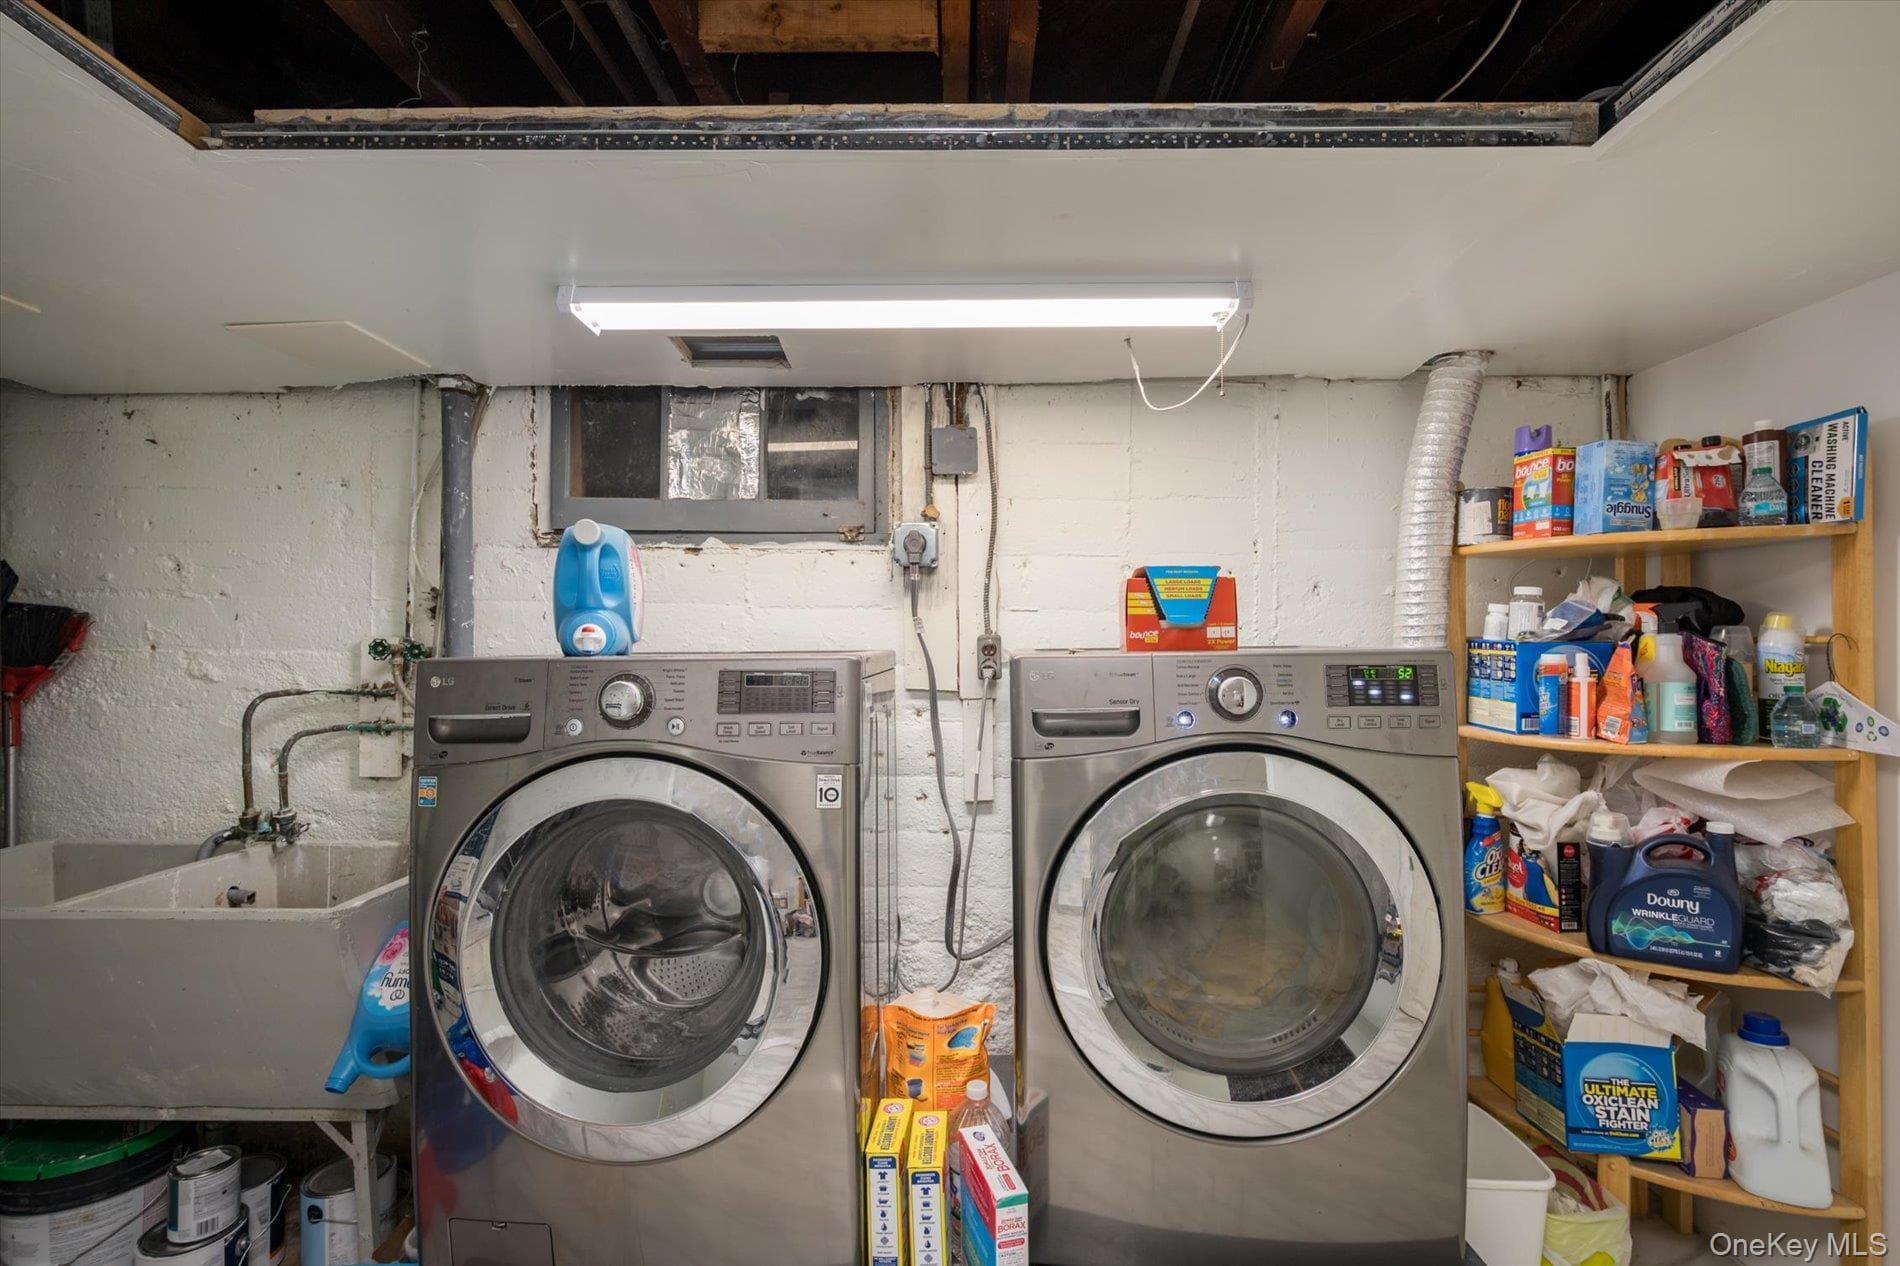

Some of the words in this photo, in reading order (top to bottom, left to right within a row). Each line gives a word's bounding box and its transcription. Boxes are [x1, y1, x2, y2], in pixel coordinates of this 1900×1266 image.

[1825, 422, 1838, 470] WASHING
[1516, 458, 1549, 480] bounce
[1810, 460, 1823, 520] CLEANER
[1824, 473, 1836, 520] MACHINE
[1606, 502, 1652, 518] Snuggle
[1129, 630, 1159, 640] bounce
[442, 678, 455, 686] LG
[818, 786, 840, 803] 10
[1646, 893, 1700, 914] Downy
[1584, 1083, 1657, 1098] ULTIMATE
[1610, 1079, 1630, 1087] THE
[1582, 1095, 1659, 1109] OXICLEAN
[1595, 1106, 1651, 1122] STAIN
[1598, 1119, 1648, 1130] FIGHTER
[997, 1221, 1026, 1233] BORAX
